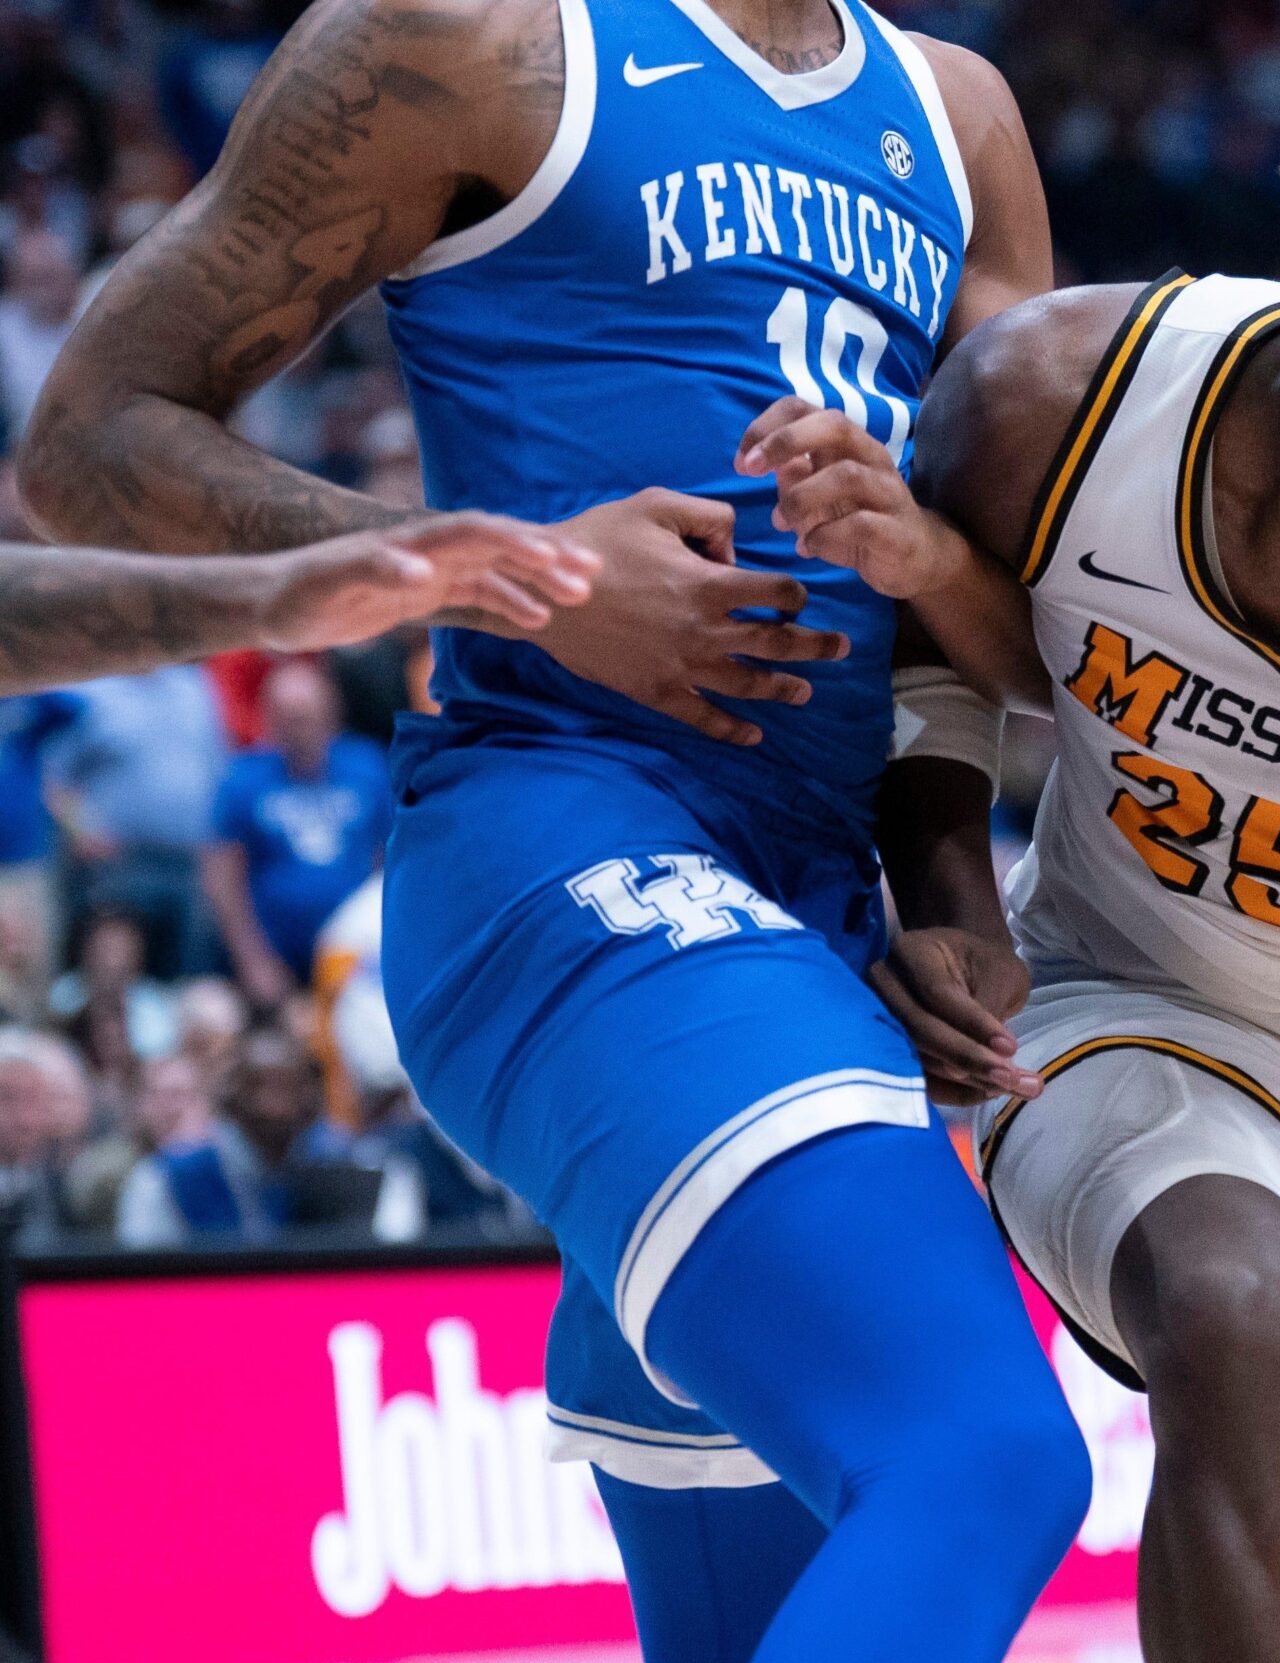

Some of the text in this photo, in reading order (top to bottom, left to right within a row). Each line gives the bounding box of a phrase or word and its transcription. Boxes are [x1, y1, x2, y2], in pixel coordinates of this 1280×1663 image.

[884, 133, 913, 176] SEC
[640, 162, 949, 339] KENTUCKY
[766, 286, 911, 469] 10
[564, 854, 806, 951] UK
